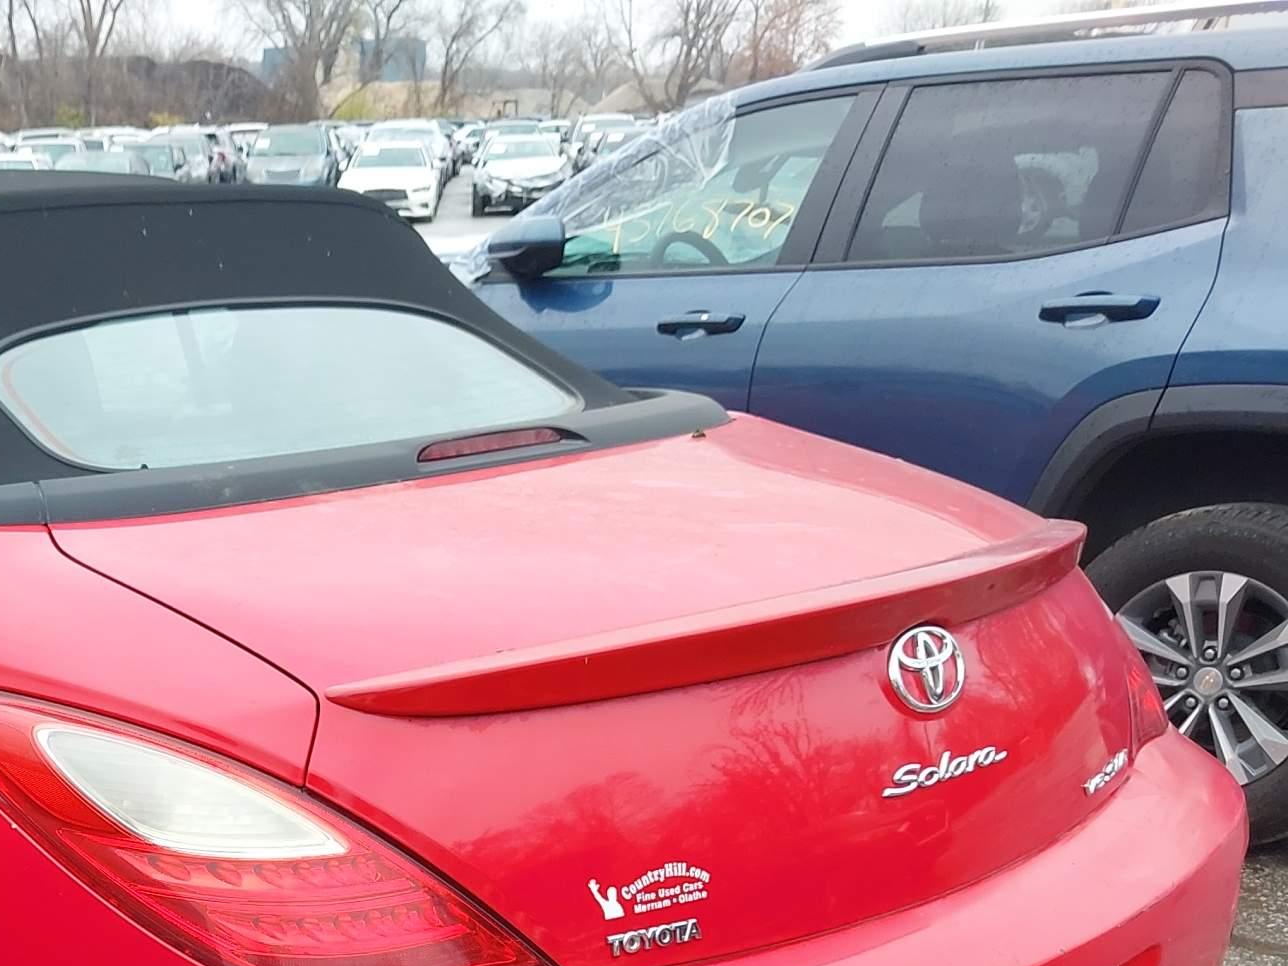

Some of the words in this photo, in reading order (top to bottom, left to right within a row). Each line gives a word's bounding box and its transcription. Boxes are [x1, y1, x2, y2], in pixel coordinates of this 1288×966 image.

[882, 746, 1008, 798] Solara
[621, 862, 710, 900] CountryHill.com
[636, 892, 656, 903] Fine
[658, 885, 681, 898] Used
[682, 881, 704, 892] Cars
[678, 890, 707, 904] Olathe
[607, 918, 702, 957] TOYOTA
